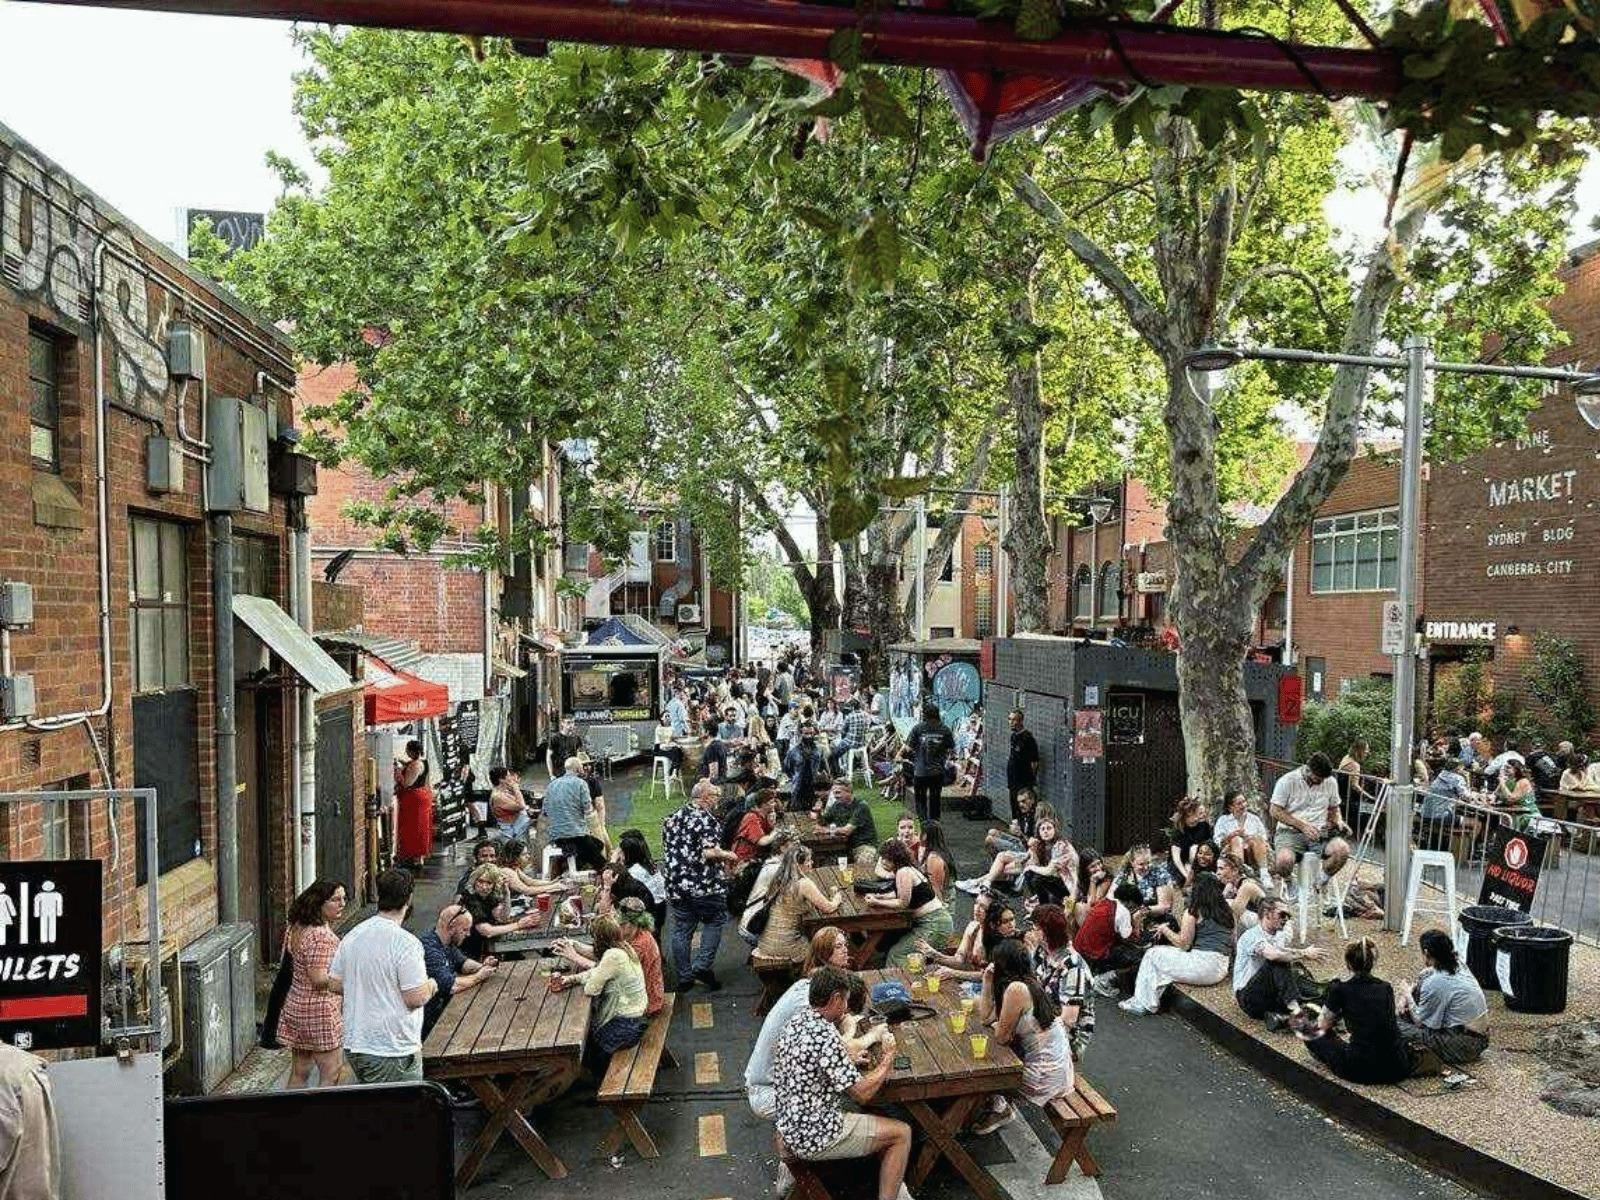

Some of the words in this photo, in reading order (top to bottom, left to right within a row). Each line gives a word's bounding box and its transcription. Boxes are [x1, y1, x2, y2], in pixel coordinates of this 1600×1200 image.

[1488, 470, 1577, 508] MARKET
[1487, 531, 1527, 546] SYDNEY
[1486, 562, 1541, 578] CANBERRA
[1546, 560, 1573, 574] CITY
[1425, 620, 1497, 641] ENTRANCE
[0, 953, 80, 981] ILETS
